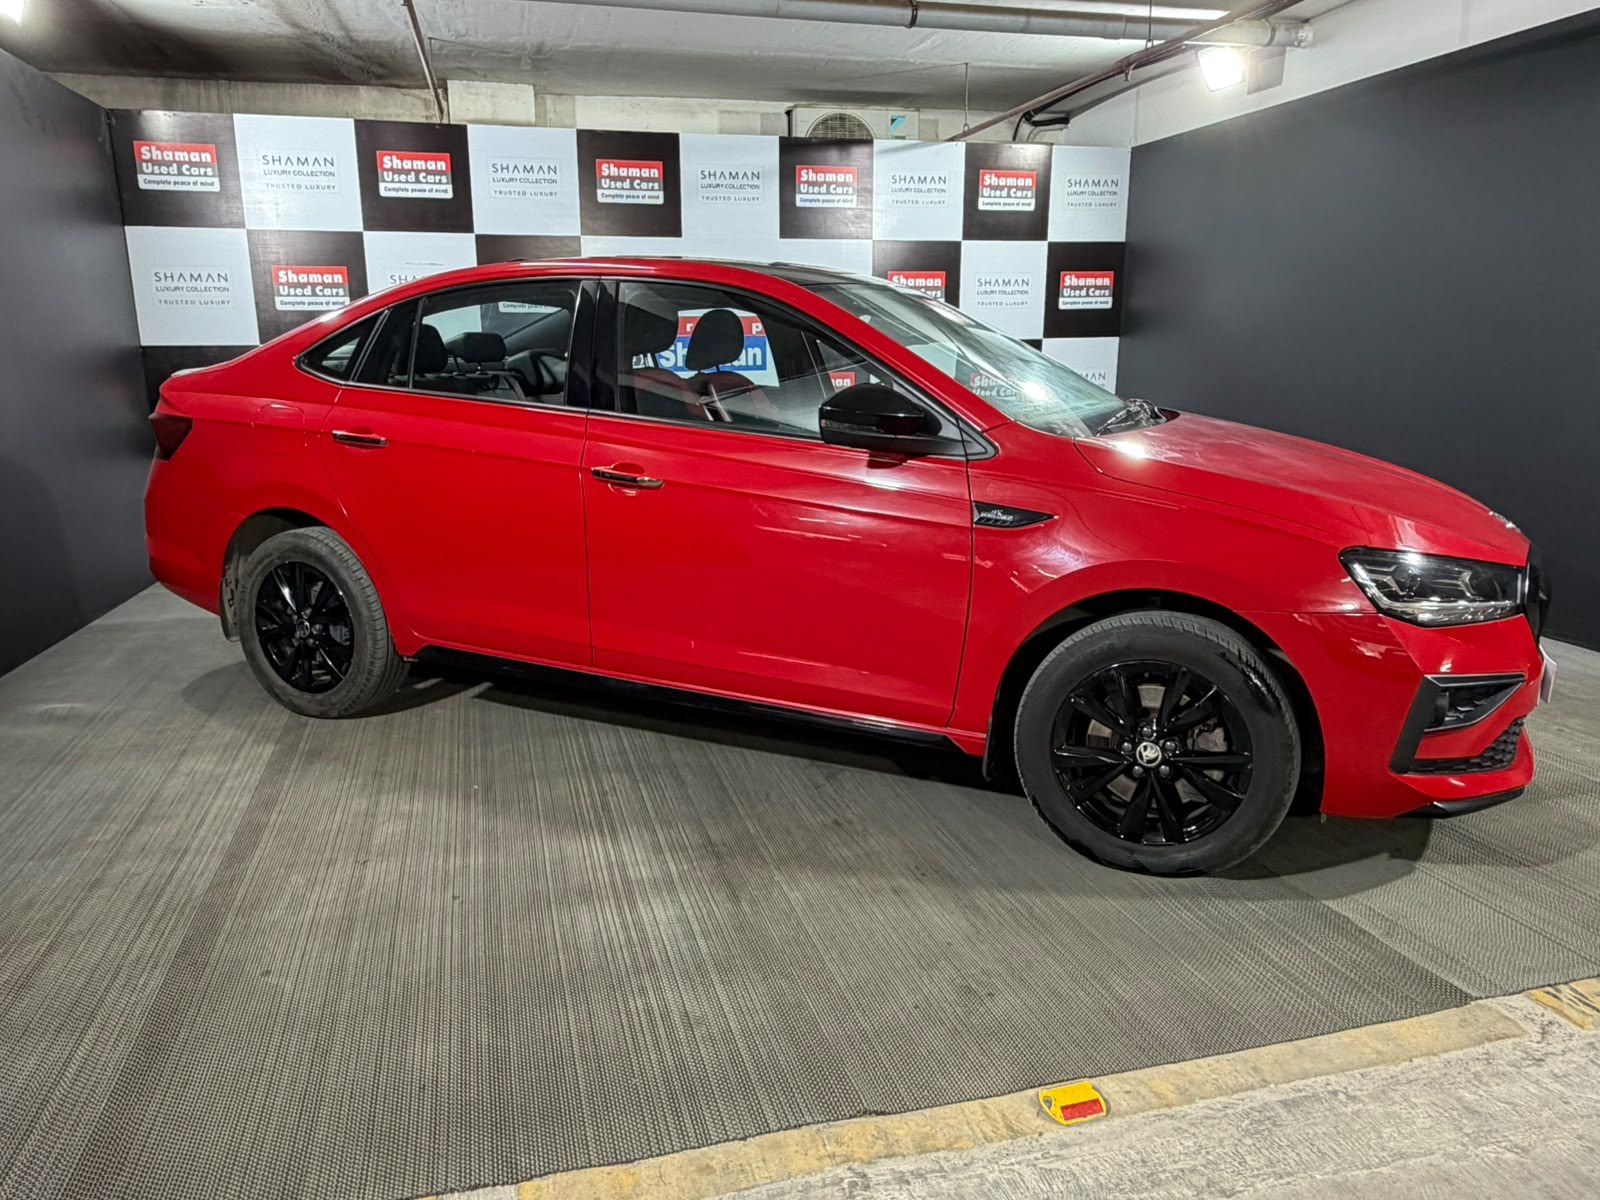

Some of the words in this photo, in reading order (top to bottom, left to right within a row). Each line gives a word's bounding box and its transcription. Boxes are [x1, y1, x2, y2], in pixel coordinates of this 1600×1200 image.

[141, 145, 212, 162] Shaman
[262, 154, 335, 167] SHAMAN
[383, 155, 446, 171] Shaman
[142, 162, 178, 175] Used
[182, 164, 213, 176] Cars
[263, 168, 291, 176] LUXURY
[491, 163, 557, 175] SHAMAN
[601, 163, 659, 178] Shaman
[700, 170, 760, 180] SHAMAN
[383, 171, 415, 182] Used
[419, 172, 448, 183] Cars
[800, 169, 853, 182] Shaman
[891, 174, 947, 185] SHAMAN
[983, 173, 1032, 186] Shaman
[601, 178, 630, 189] Used
[633, 179, 659, 190] Cars
[800, 183, 827, 193] Used
[830, 184, 853, 194] Cars
[1067, 178, 1119, 188] SHAMAN
[983, 187, 1008, 197] Used
[1010, 188, 1032, 197] Cars
[154, 271, 229, 283] SHAMAN
[278, 269, 343, 283] Shaman
[1063, 274, 1110, 286] Shaman
[977, 278, 1030, 288] SHAMAN
[279, 285, 312, 296] Used
[315, 285, 345, 296] Cars
[1063, 287, 1087, 297] Used
[1089, 287, 1110, 297] Cars
